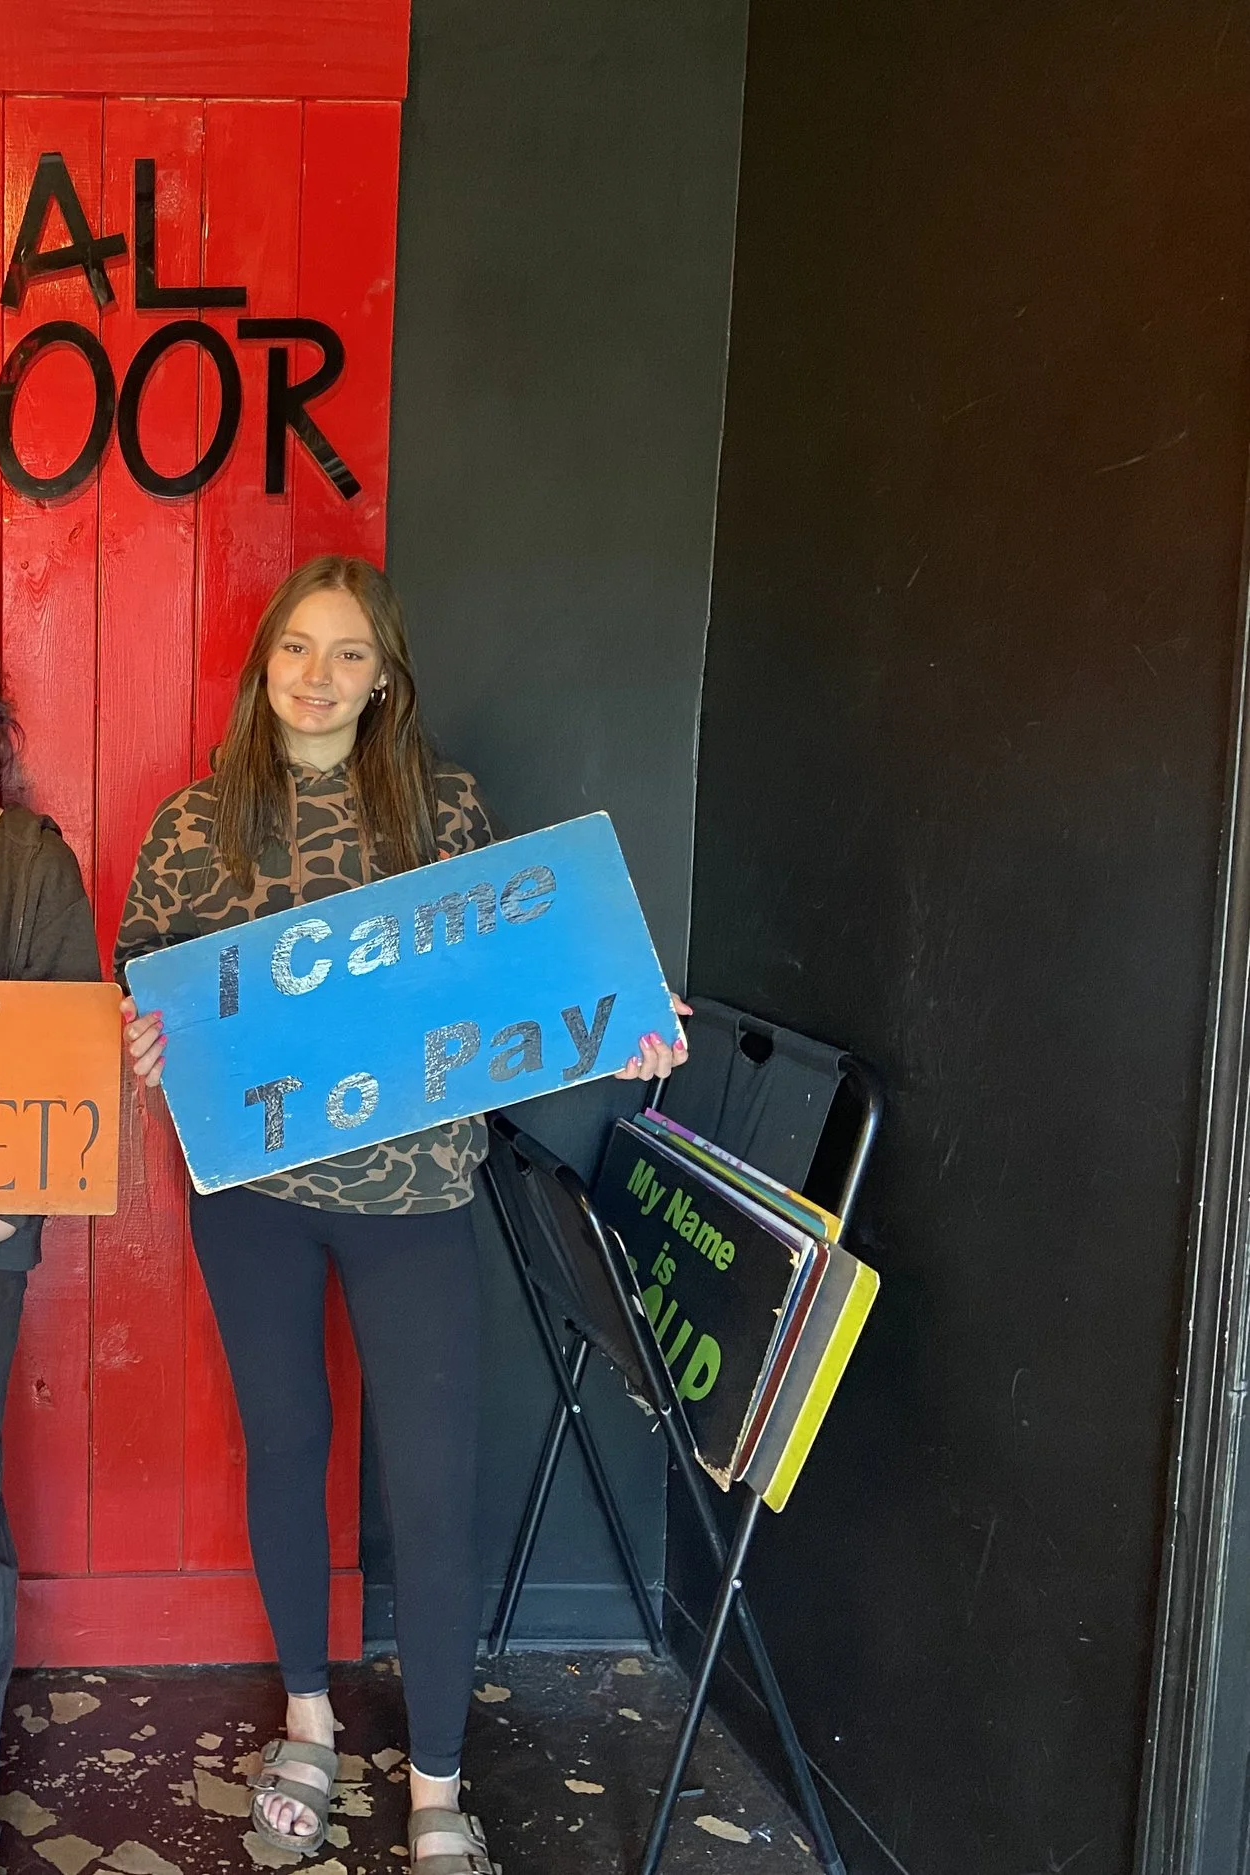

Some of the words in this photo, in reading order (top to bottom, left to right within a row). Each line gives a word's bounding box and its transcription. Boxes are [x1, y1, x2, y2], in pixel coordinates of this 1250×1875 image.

[219, 945, 240, 1020] I
[270, 864, 556, 996] Came
[424, 992, 617, 1103] Pay
[626, 1158, 666, 1216] My
[663, 1188, 736, 1271] Name
[651, 1241, 676, 1286] is
